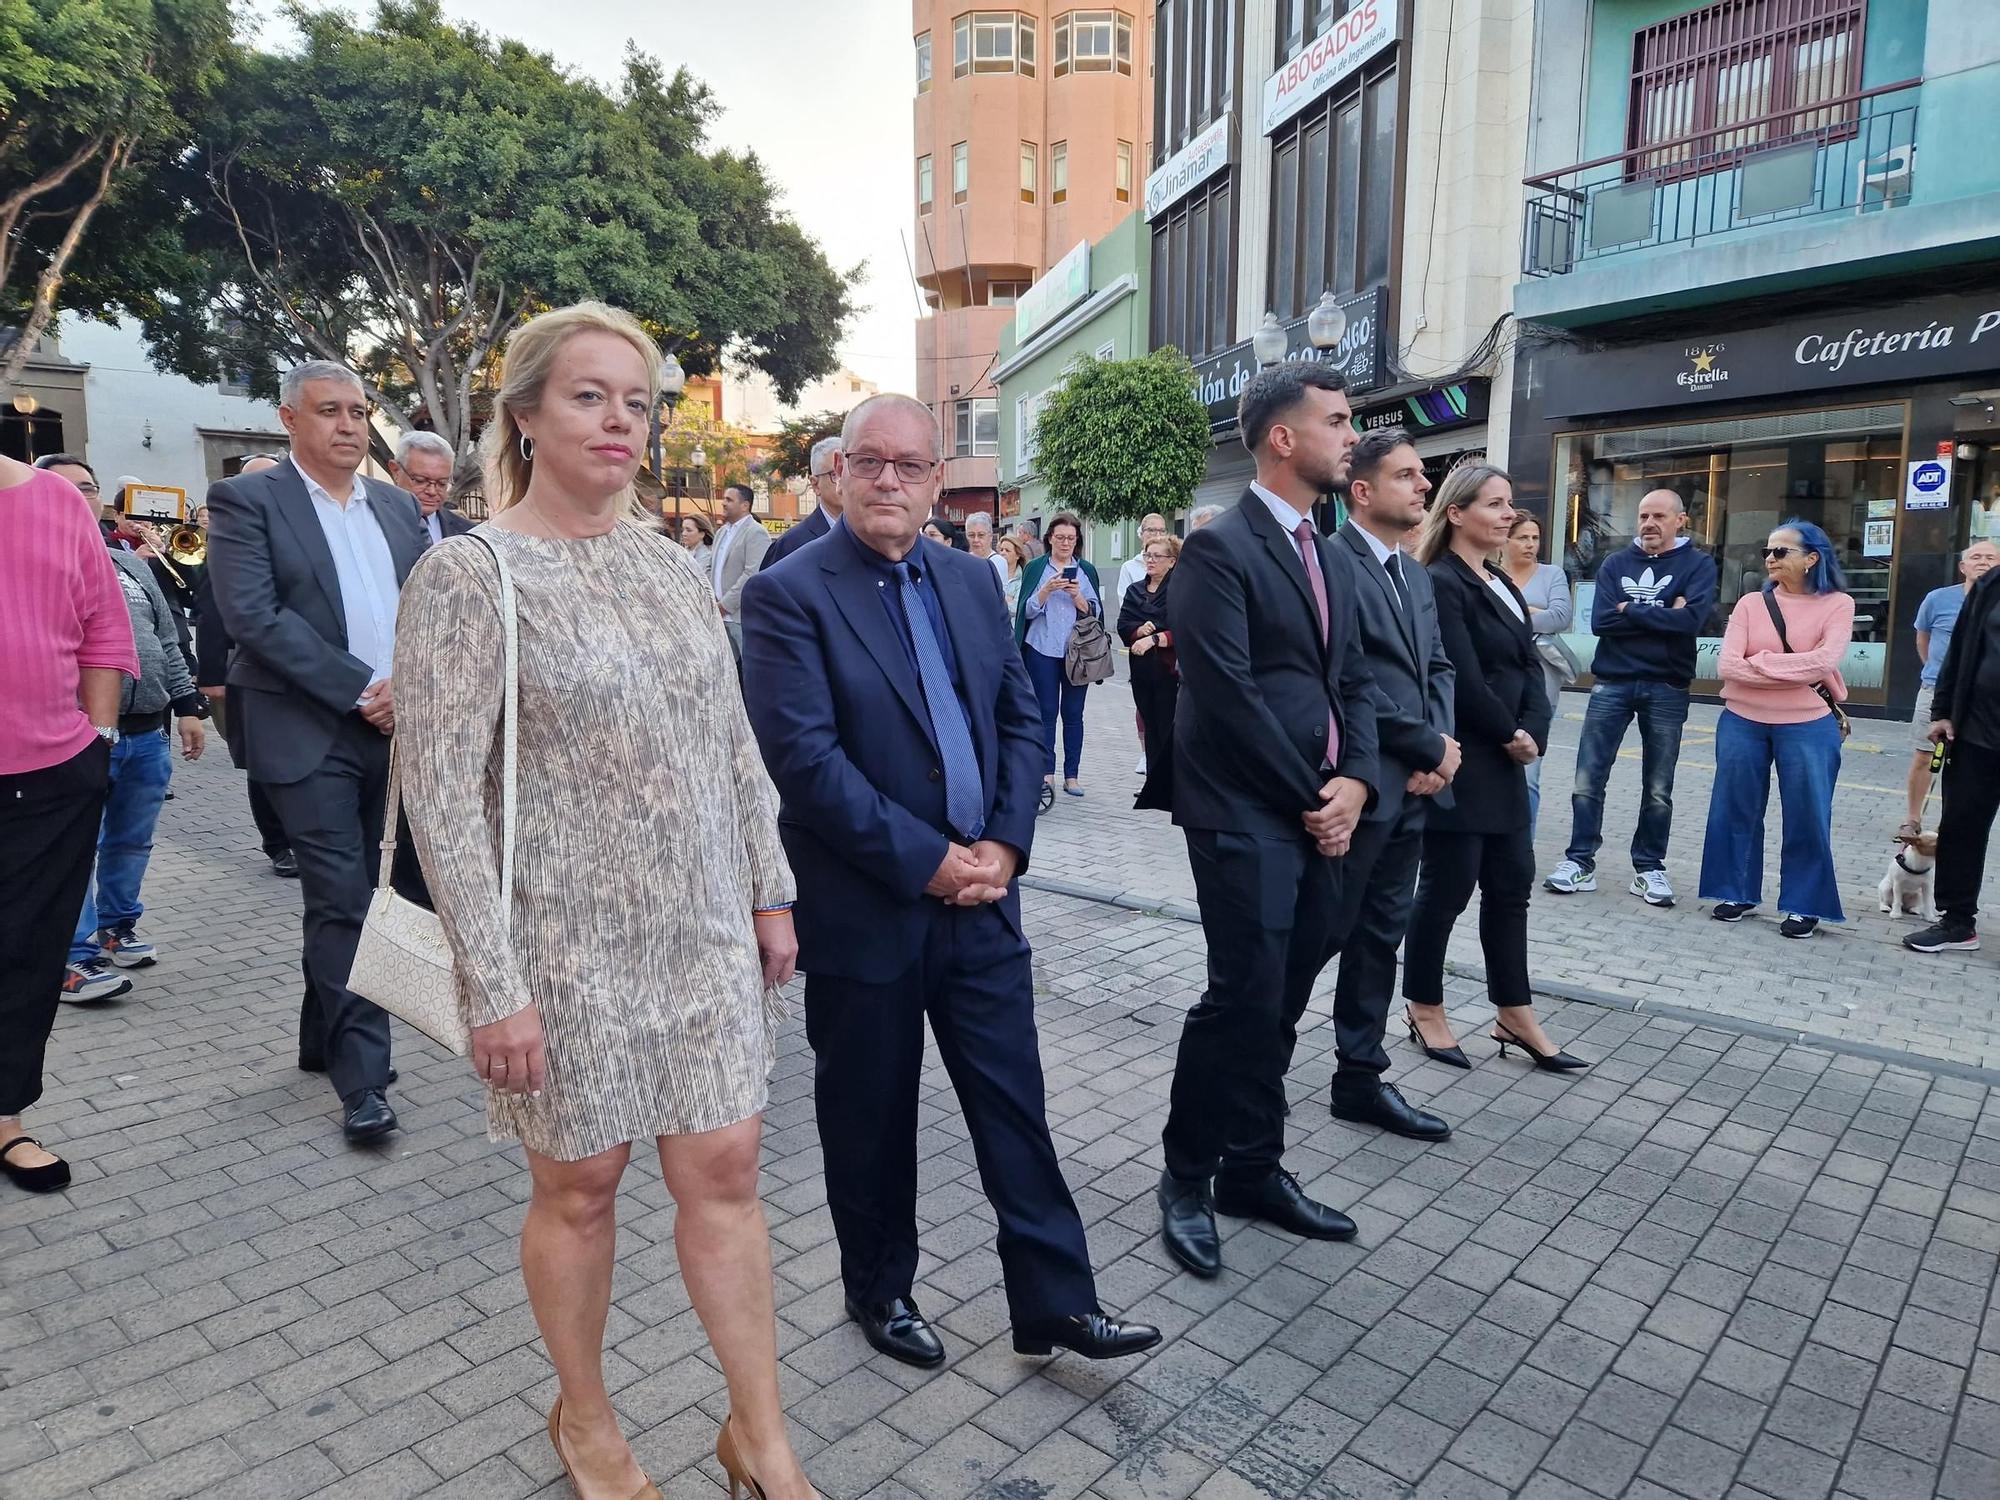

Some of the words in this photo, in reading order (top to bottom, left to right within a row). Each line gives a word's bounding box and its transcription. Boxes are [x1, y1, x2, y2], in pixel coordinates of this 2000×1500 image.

[1276, 0, 1377, 102] ABOGADOS
[1312, 66, 1337, 90] Oficina
[1338, 56, 1347, 72] de
[1161, 148, 1212, 201] Jinámar
[1794, 320, 1955, 372] Cafetería
[1229, 360, 1250, 398] de
[1350, 358, 1369, 375] RED
[1676, 367, 1729, 386] Estrella
[1366, 410, 1403, 428] VERSUS
[1917, 471, 1941, 483] ADT
